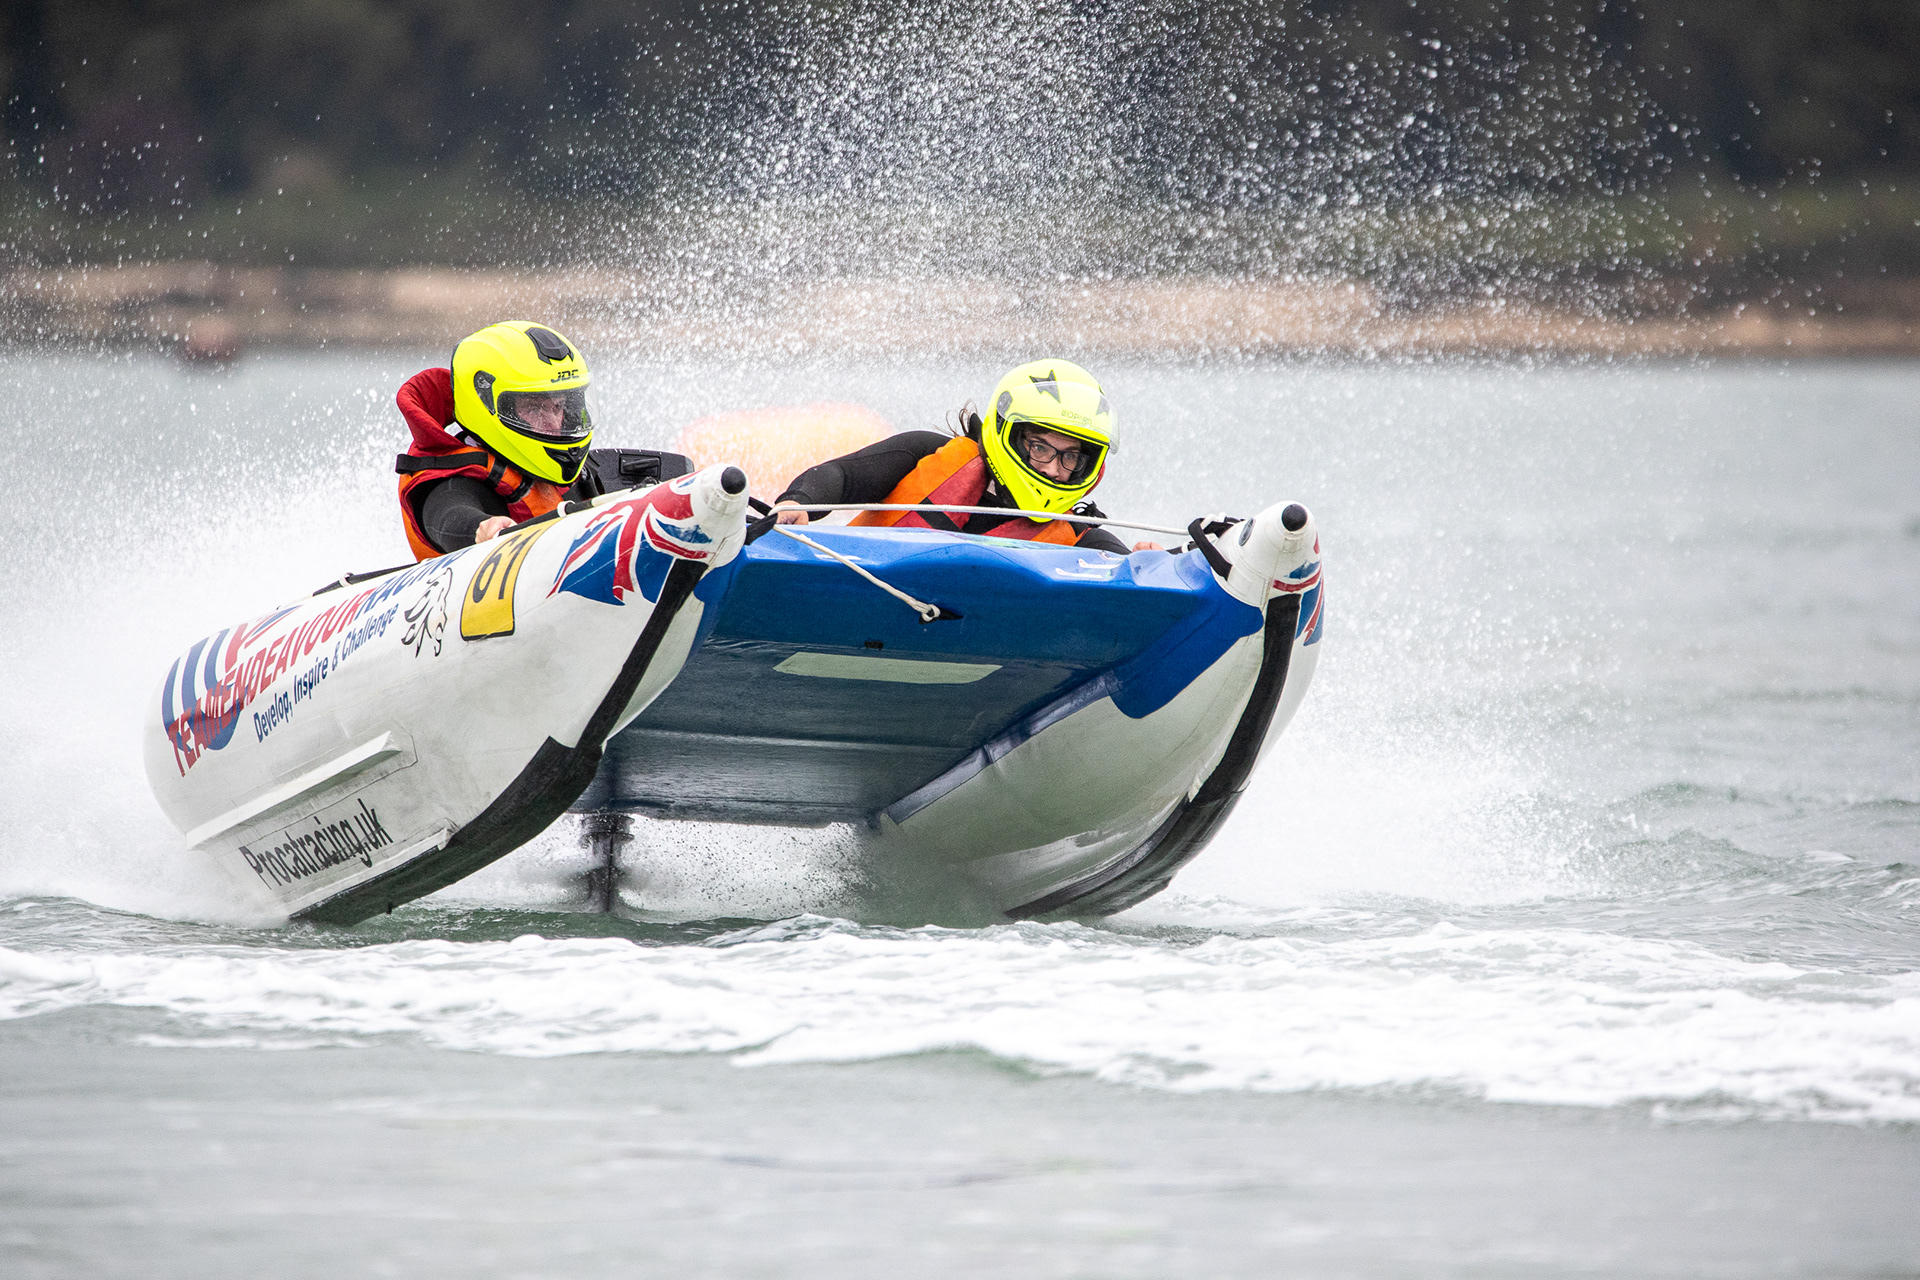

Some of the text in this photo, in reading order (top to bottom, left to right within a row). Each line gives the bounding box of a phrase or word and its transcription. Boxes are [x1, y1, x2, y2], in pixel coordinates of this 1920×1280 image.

[550, 368, 580, 384] JDC
[472, 528, 542, 604] 61
[253, 603, 399, 743] Develop, Inspire & Challenge
[238, 798, 394, 890] Procatracing.uk
